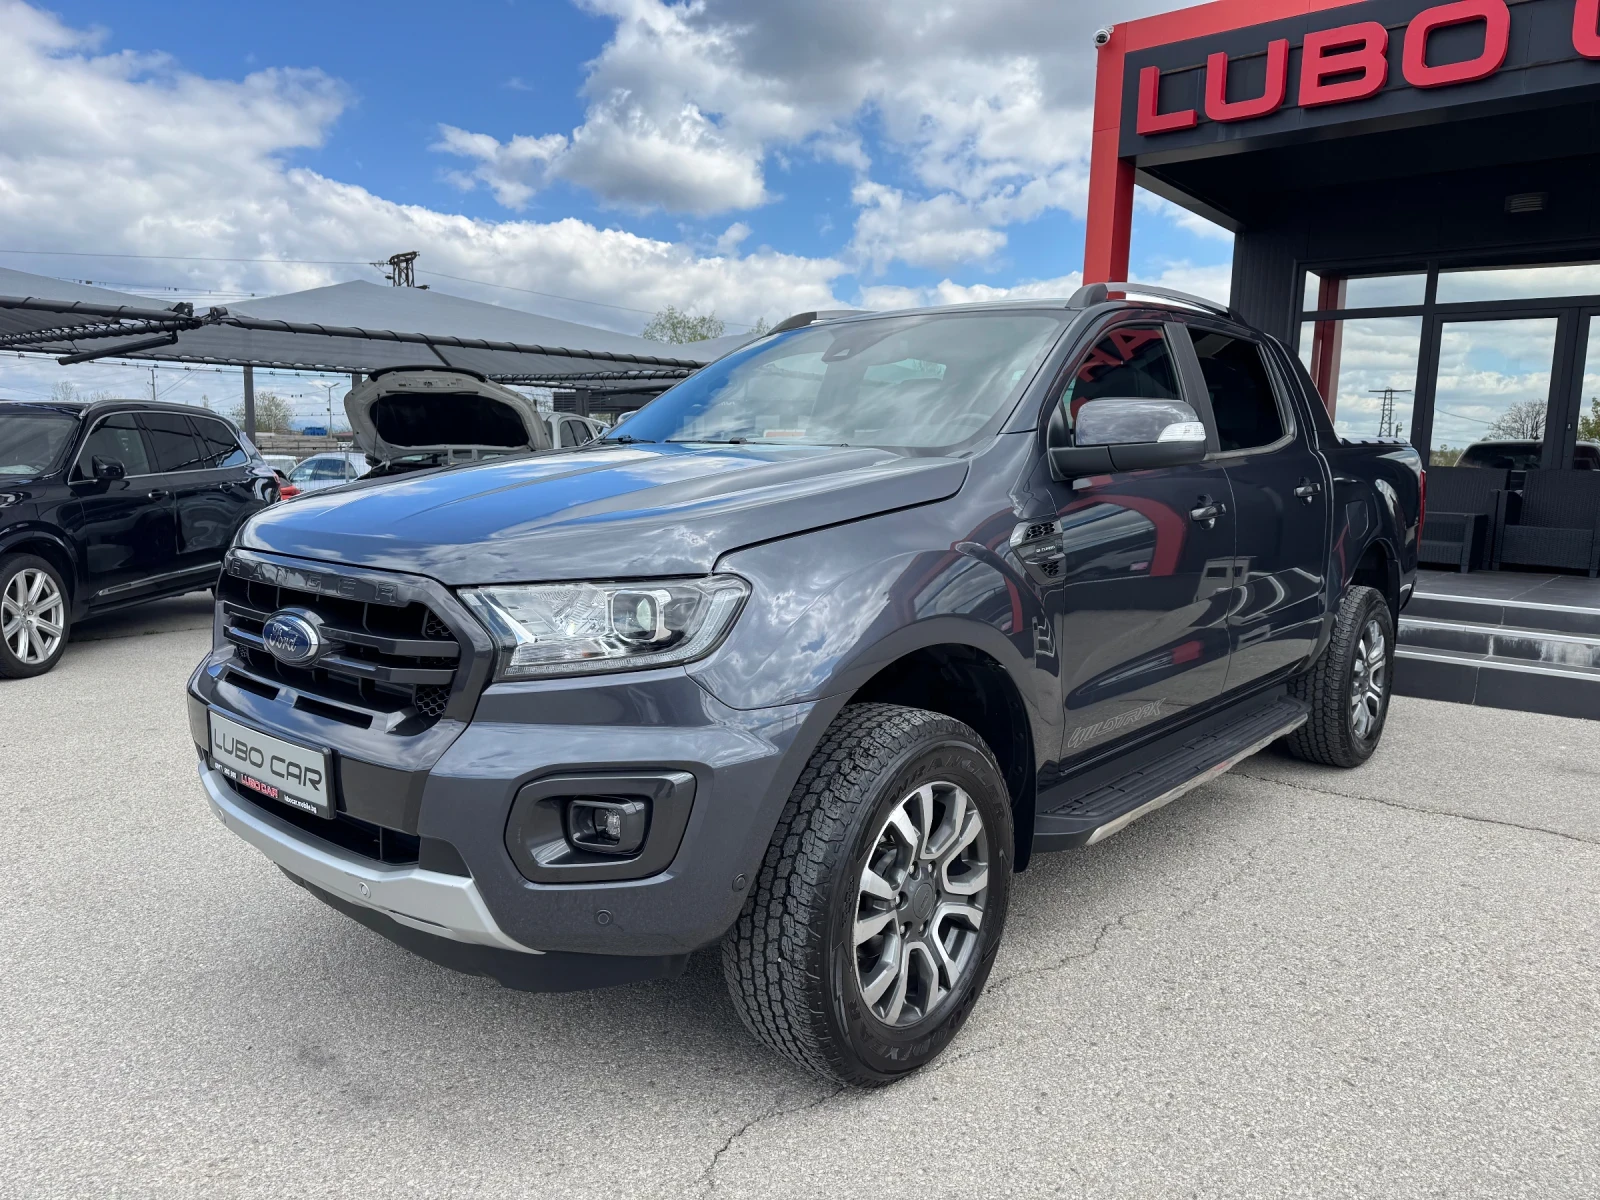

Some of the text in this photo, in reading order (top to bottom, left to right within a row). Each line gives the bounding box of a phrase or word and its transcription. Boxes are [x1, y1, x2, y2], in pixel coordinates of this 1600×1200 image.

[1136, 0, 1511, 136] LUBO
[230, 558, 398, 602] RANGER
[269, 622, 299, 652] Ford
[1067, 697, 1167, 748] WILDTRAK
[214, 728, 264, 769] LUBO
[270, 755, 322, 791] CAR
[241, 773, 278, 799] LUBO CAR
